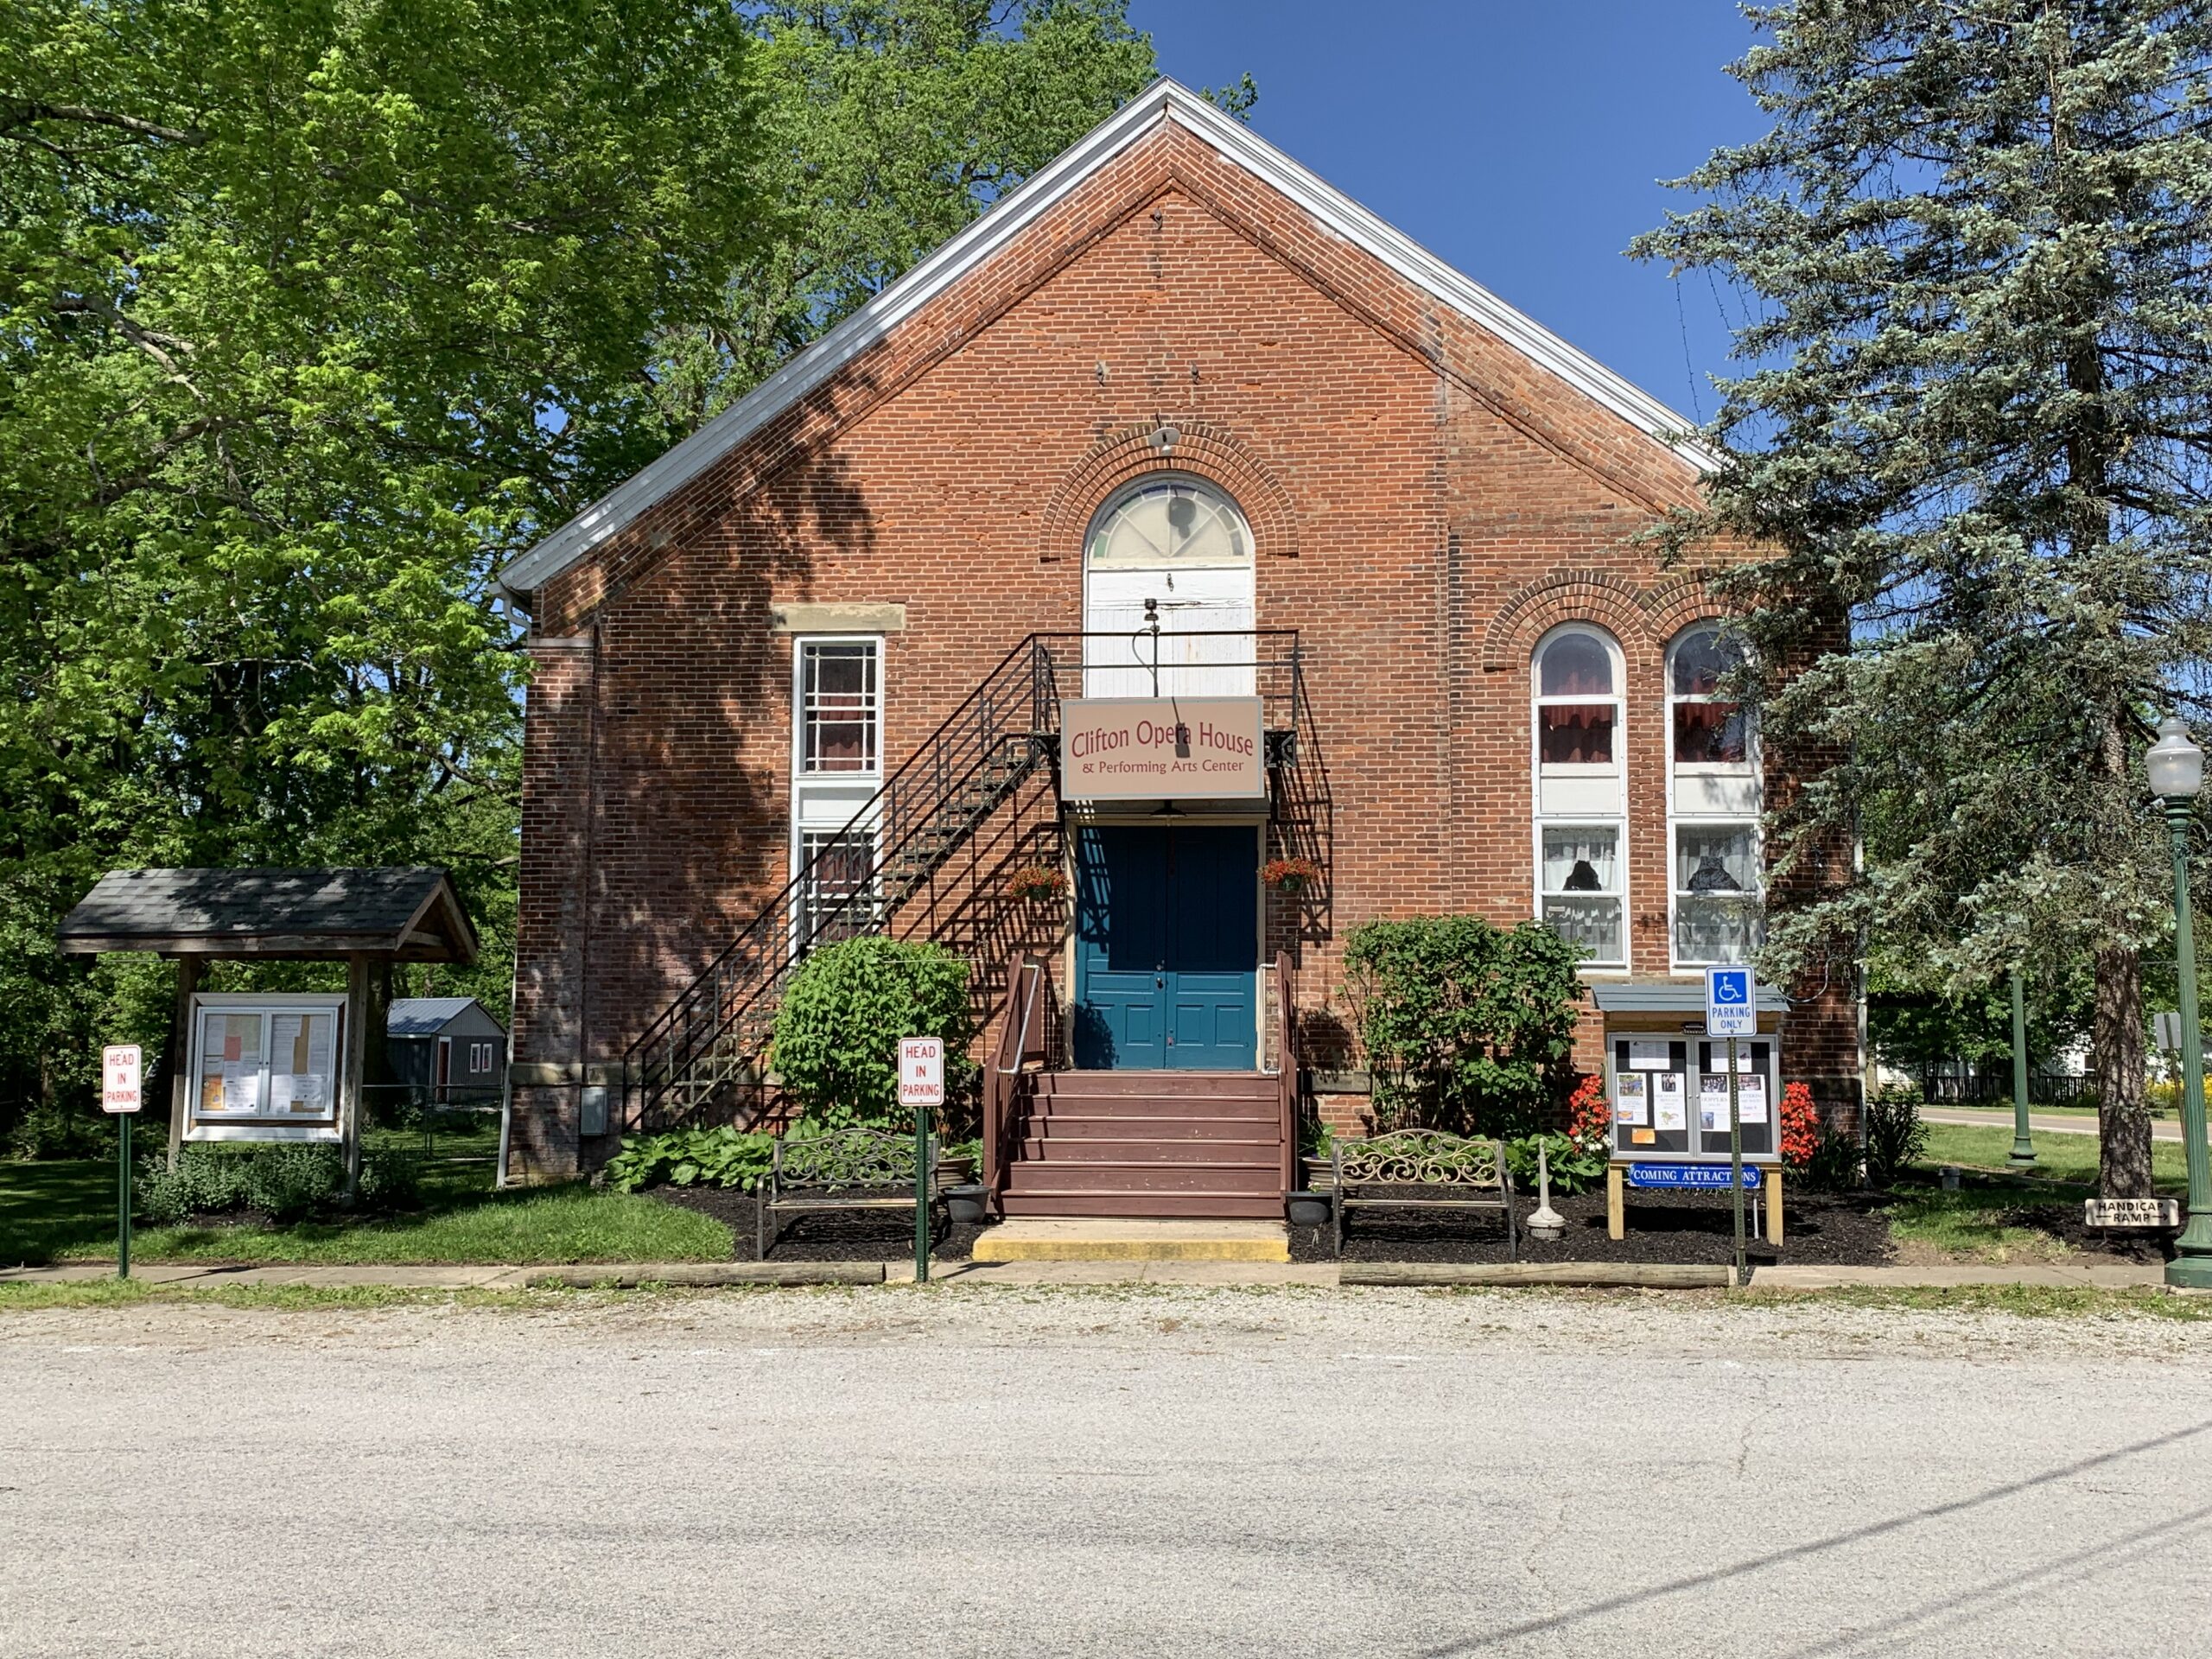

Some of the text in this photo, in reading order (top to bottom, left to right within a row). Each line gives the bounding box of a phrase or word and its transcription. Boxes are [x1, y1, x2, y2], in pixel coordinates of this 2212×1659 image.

[1071, 720, 1253, 758] Clifton Opera House
[1082, 760, 1244, 774] & Performing Arts Center
[1712, 1007, 1751, 1018] PARKING
[1720, 1020, 1742, 1029] ONLY
[906, 1046, 936, 1058] HEAD
[109, 1053, 134, 1066] HEAD
[916, 1065, 926, 1077] IN
[118, 1072, 126, 1084] IN
[903, 1084, 939, 1096] PARKING
[106, 1090, 137, 1103] PARKING
[1633, 1170, 1757, 1182] COMING ATTRACTNS
[2098, 1202, 2164, 1211] HANDICAP
[2113, 1213, 2150, 1223] RAMP
